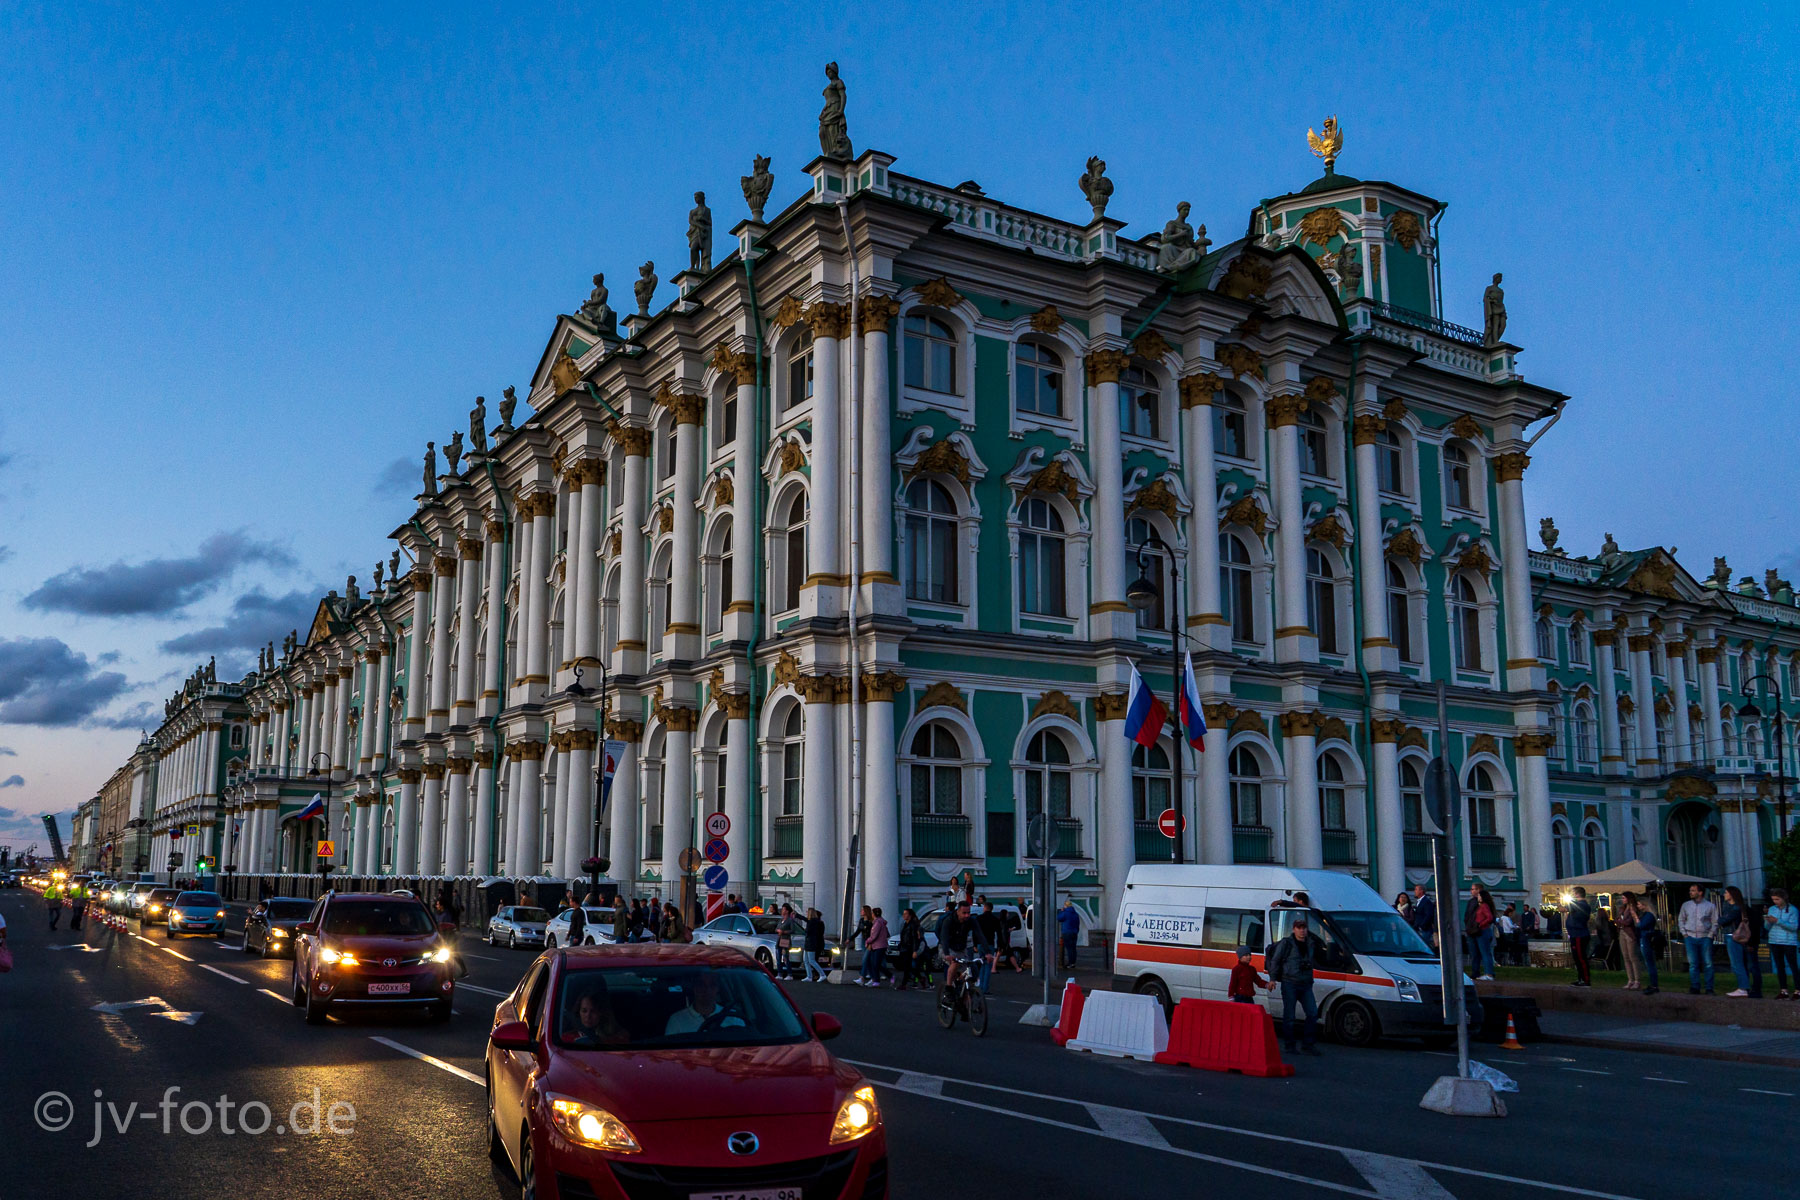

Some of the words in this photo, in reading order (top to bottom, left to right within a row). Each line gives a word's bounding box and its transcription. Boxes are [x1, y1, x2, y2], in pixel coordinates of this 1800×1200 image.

[711, 819, 726, 830] 40
[1136, 918, 1200, 932] «ЛЕНСВЕТ»
[1149, 931, 1179, 941] 312-95-94
